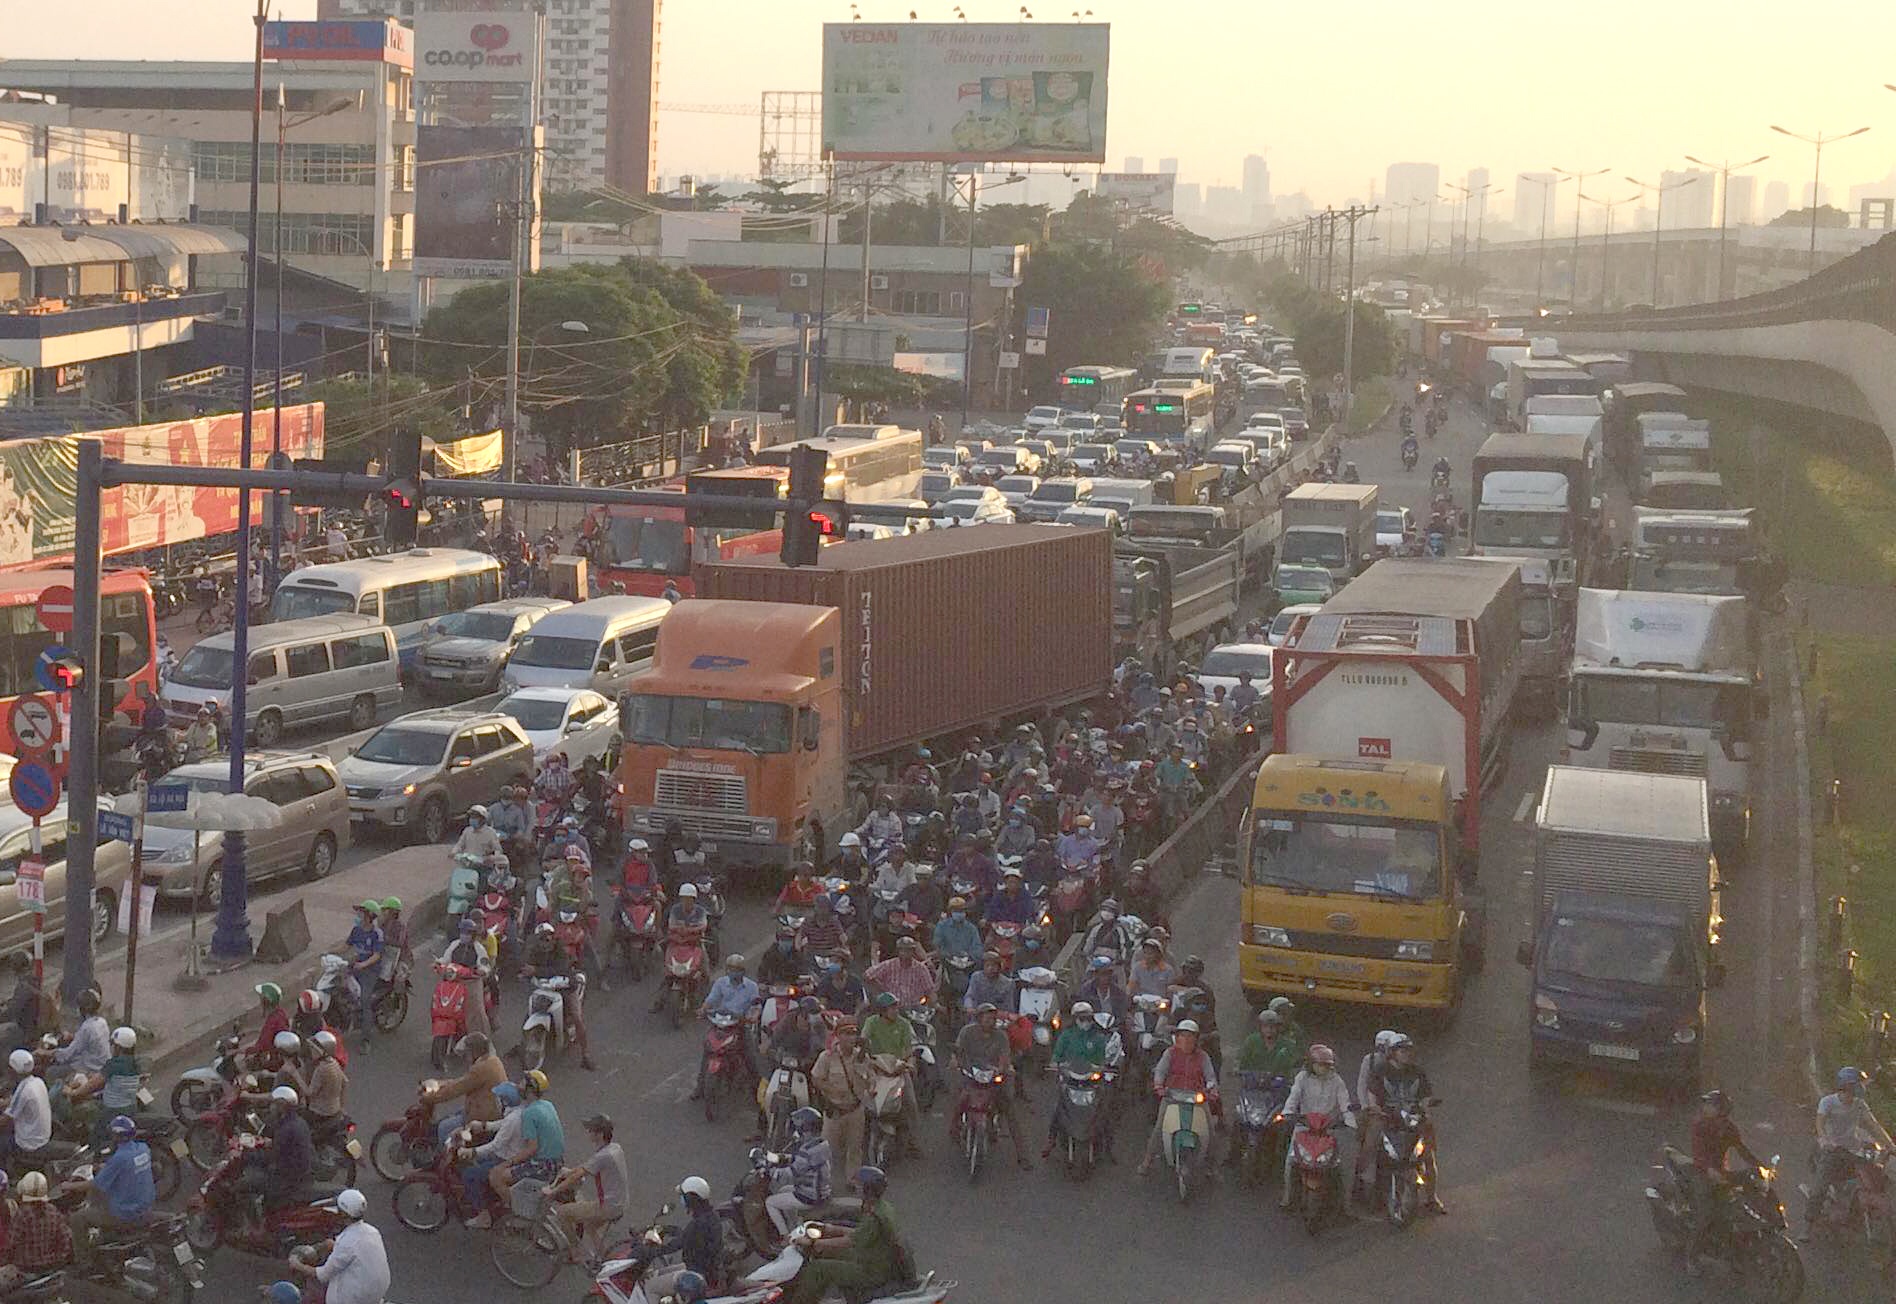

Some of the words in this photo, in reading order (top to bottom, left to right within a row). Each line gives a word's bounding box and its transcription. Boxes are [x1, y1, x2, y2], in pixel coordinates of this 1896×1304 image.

[840, 30, 898, 43] VEDAN
[485, 53, 522, 66] mart
[1359, 744, 1389, 755] TAL
